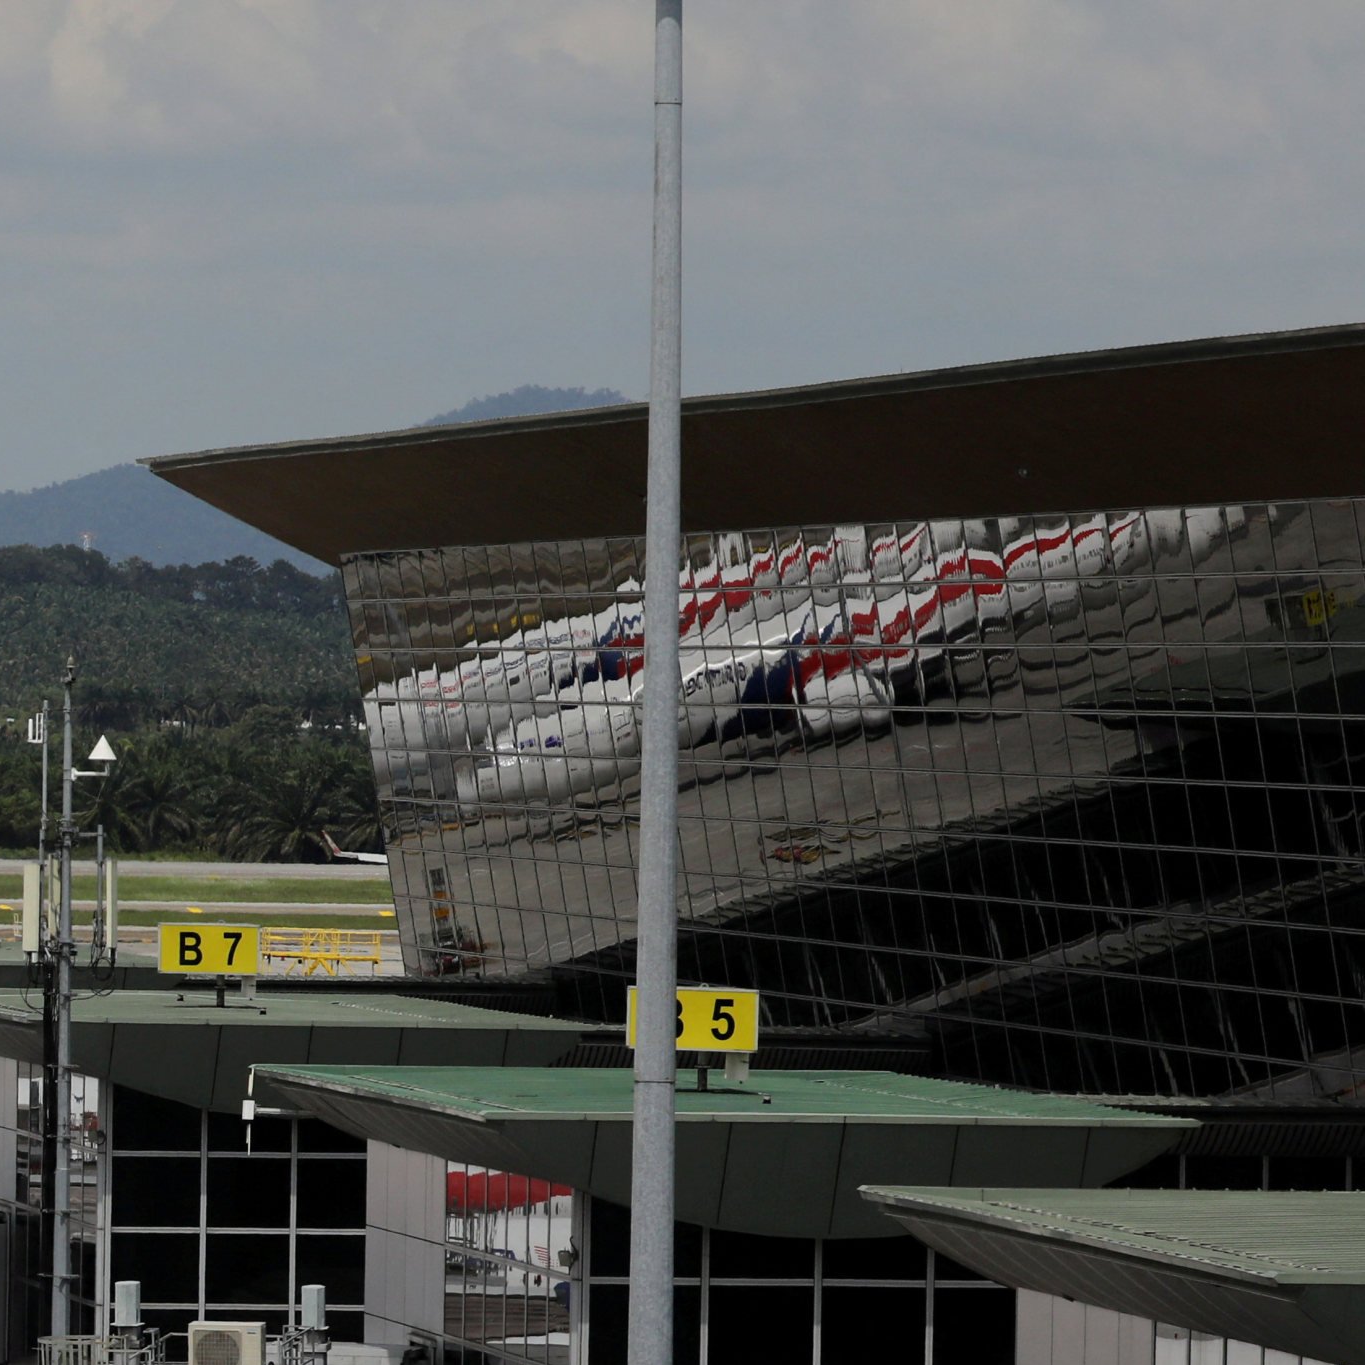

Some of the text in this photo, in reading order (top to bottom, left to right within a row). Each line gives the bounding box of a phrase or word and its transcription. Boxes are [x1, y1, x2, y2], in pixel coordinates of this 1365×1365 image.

[179, 931, 243, 966] B 7
[710, 998, 736, 1041] 5
